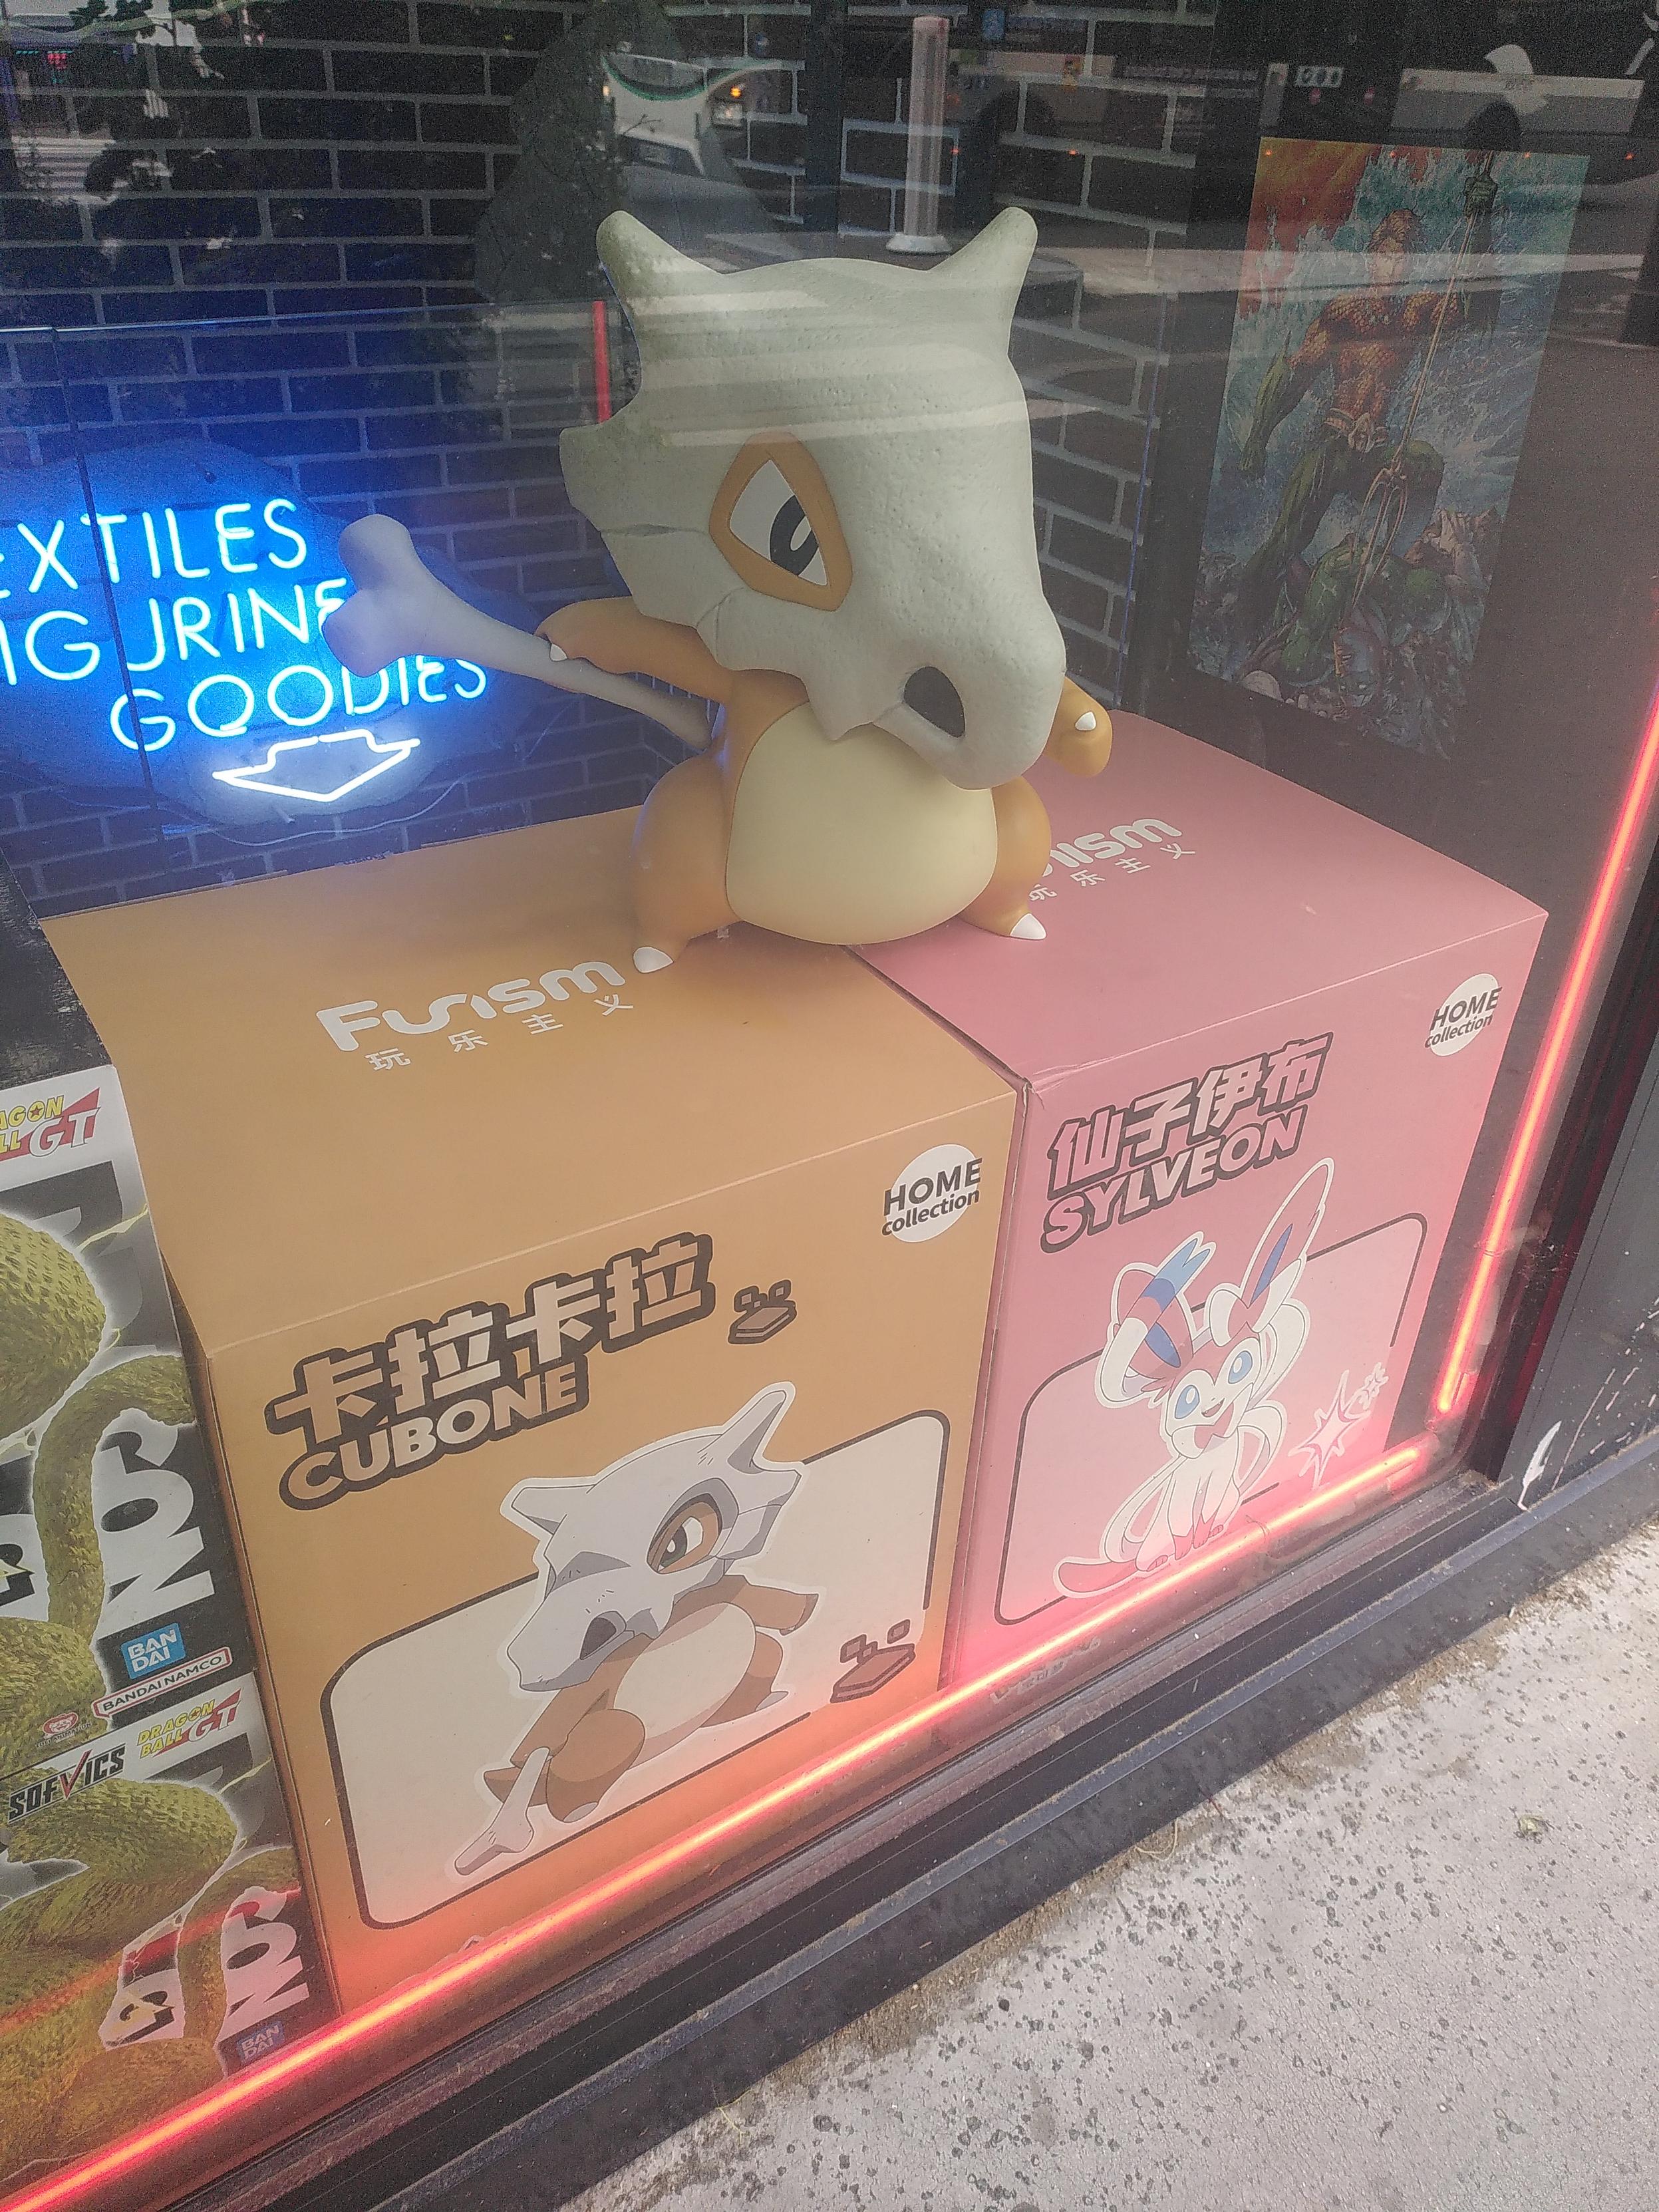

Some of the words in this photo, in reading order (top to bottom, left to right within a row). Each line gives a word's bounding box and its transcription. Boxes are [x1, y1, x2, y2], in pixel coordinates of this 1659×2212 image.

[0, 498, 307, 597] XTILES
[365, 994, 634, 1070] 玩乐主义
[1424, 1014, 1493, 1048] collection
[1430, 986, 1503, 1032] HOME
[29, 1106, 101, 1158] GT
[1046, 1032, 1333, 1196] 仙子伊布
[883, 1157, 982, 1217] HOME
[1040, 1106, 1307, 1253] SYLVEON
[881, 1189, 980, 1236] collection
[266, 1233, 713, 1448] 卡拉卡拉
[281, 1354, 588, 1507] CUBONE
[102, 1680, 162, 1712] BANDAI
[164, 1655, 223, 1687] NAMCO
[136, 1698, 216, 1746] DRAGON
[139, 1728, 183, 1760] BALL
[188, 1700, 241, 1743] GT
